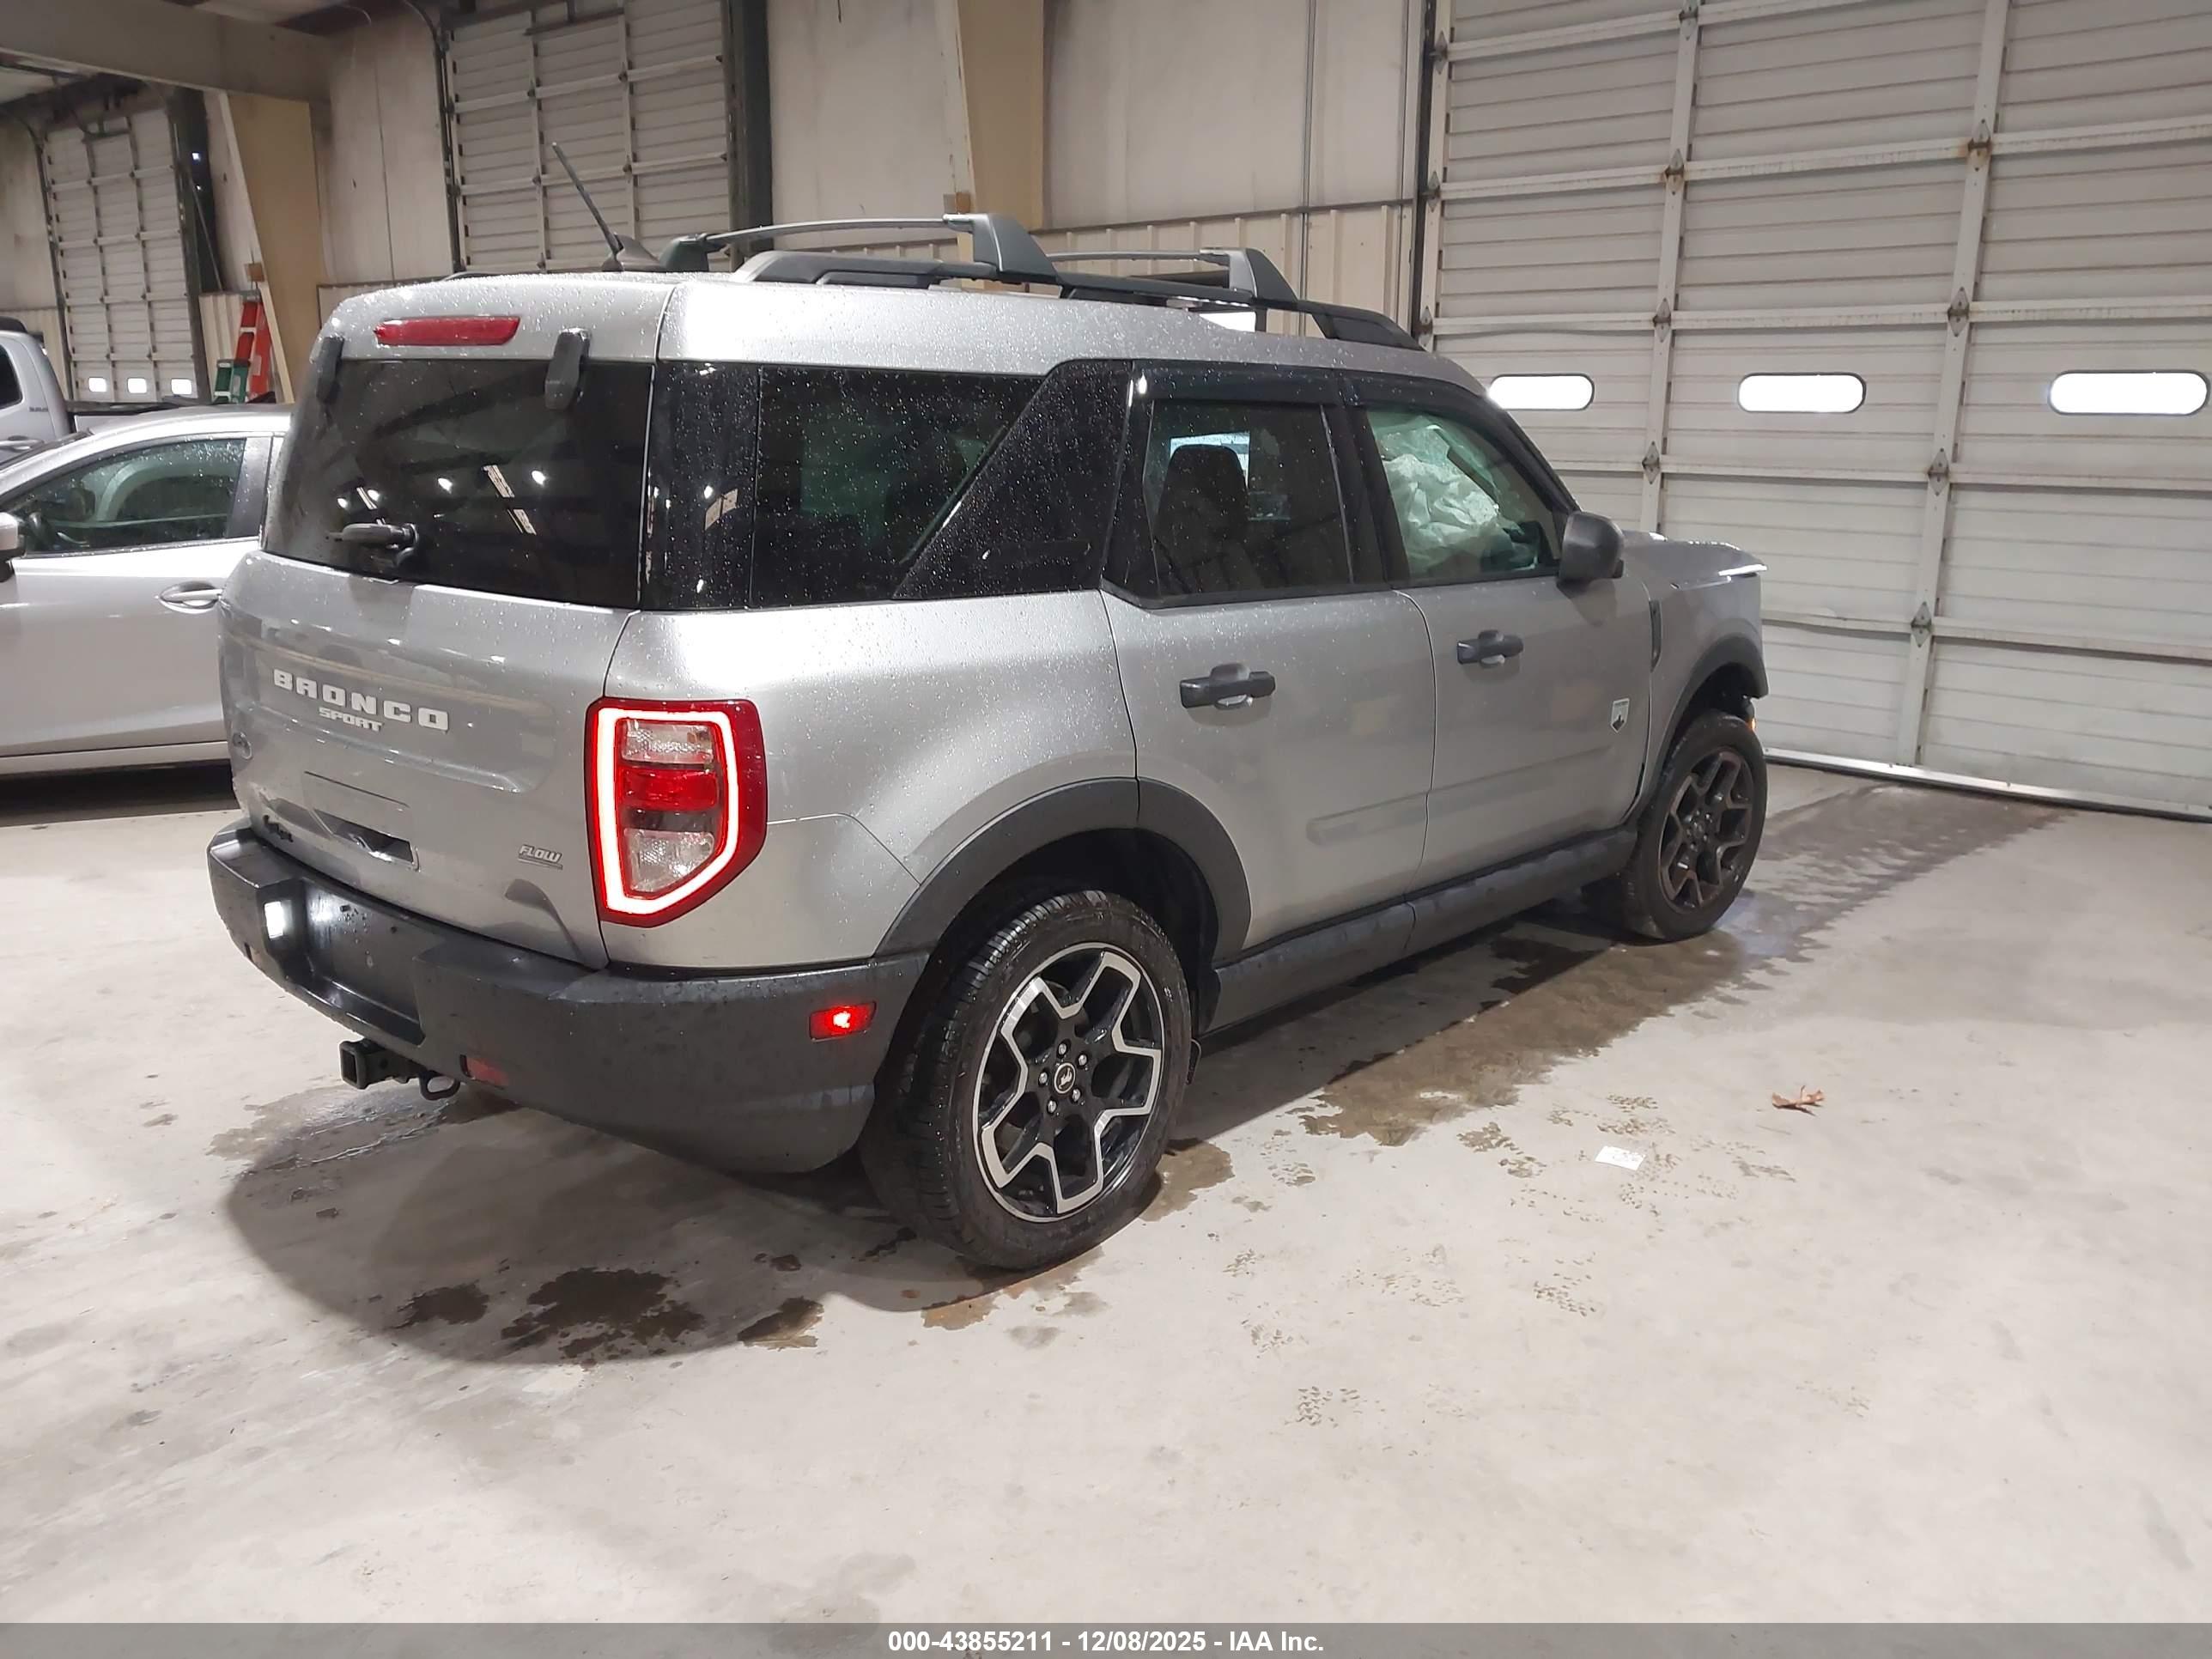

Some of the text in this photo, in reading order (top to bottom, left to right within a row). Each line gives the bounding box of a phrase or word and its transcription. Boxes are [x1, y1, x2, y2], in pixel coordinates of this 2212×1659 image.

[273, 668, 449, 732] BRONCO
[319, 706, 384, 732] SPORT
[519, 844, 562, 864] FLOW
